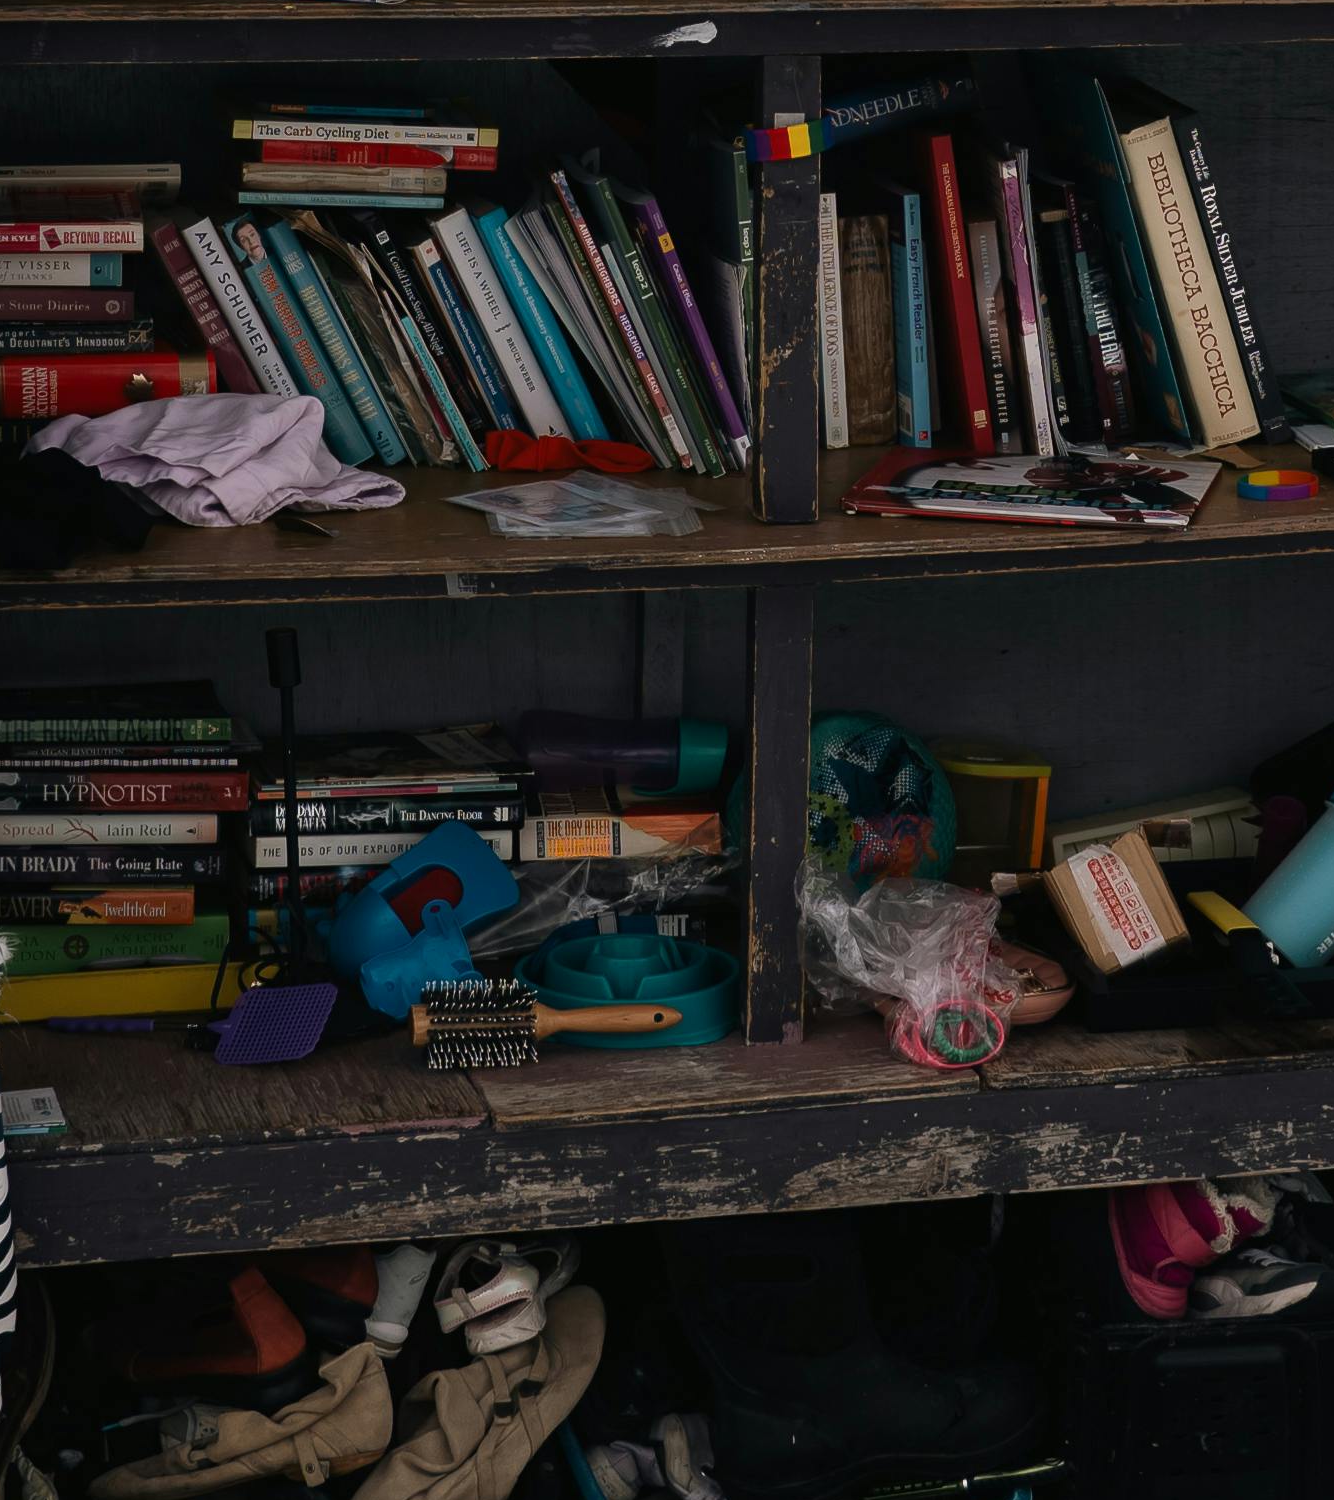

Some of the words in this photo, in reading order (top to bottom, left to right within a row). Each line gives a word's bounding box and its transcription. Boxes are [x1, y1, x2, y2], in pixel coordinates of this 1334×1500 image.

[257, 124, 281, 137] The
[284, 124, 312, 137] Carb
[316, 126, 362, 141] Cycling
[364, 127, 389, 139] Diet
[12, 234, 37, 242] KYLE
[63, 231, 99, 244] BEYOND
[103, 230, 136, 243] RECALL
[908, 238, 920, 263] Easy
[1198, 183, 1226, 234] ROYAL
[1212, 231, 1241, 286] SILVER
[1227, 284, 1259, 347] JUBILEE
[195, 231, 224, 266] AMY
[218, 272, 269, 358] SCHUMER
[910, 266, 922, 300] French
[1145, 150, 1204, 302] BIBLIOTHECA
[1189, 303, 1238, 418] BACCHICA
[10, 300, 42, 312] Stone
[47, 300, 90, 312] Diaries
[577, 221, 599, 257] ANIMAL
[592, 254, 621, 307] NEIGHBORS
[617, 312, 645, 361] HEDGEHOG
[645, 372, 660, 395] LEACH
[911, 303, 924, 340] Reader
[10, 337, 71, 348] DEBUTANTE'S
[76, 337, 126, 347] HANDBOOK
[504, 336, 523, 364] BRUCE
[516, 363, 537, 393] WEBER
[43, 783, 172, 806] HYPNOTIST
[400, 810, 417, 822] THE
[419, 809, 456, 821] DANCING
[457, 809, 483, 821] FLOOR
[263, 848, 281, 857] THE
[22, 856, 79, 873] BRADY
[87, 857, 111, 871] The
[116, 858, 151, 875] Going
[155, 858, 183, 871] Rate
[103, 903, 142, 918] Twelfth
[143, 903, 166, 918] Card
